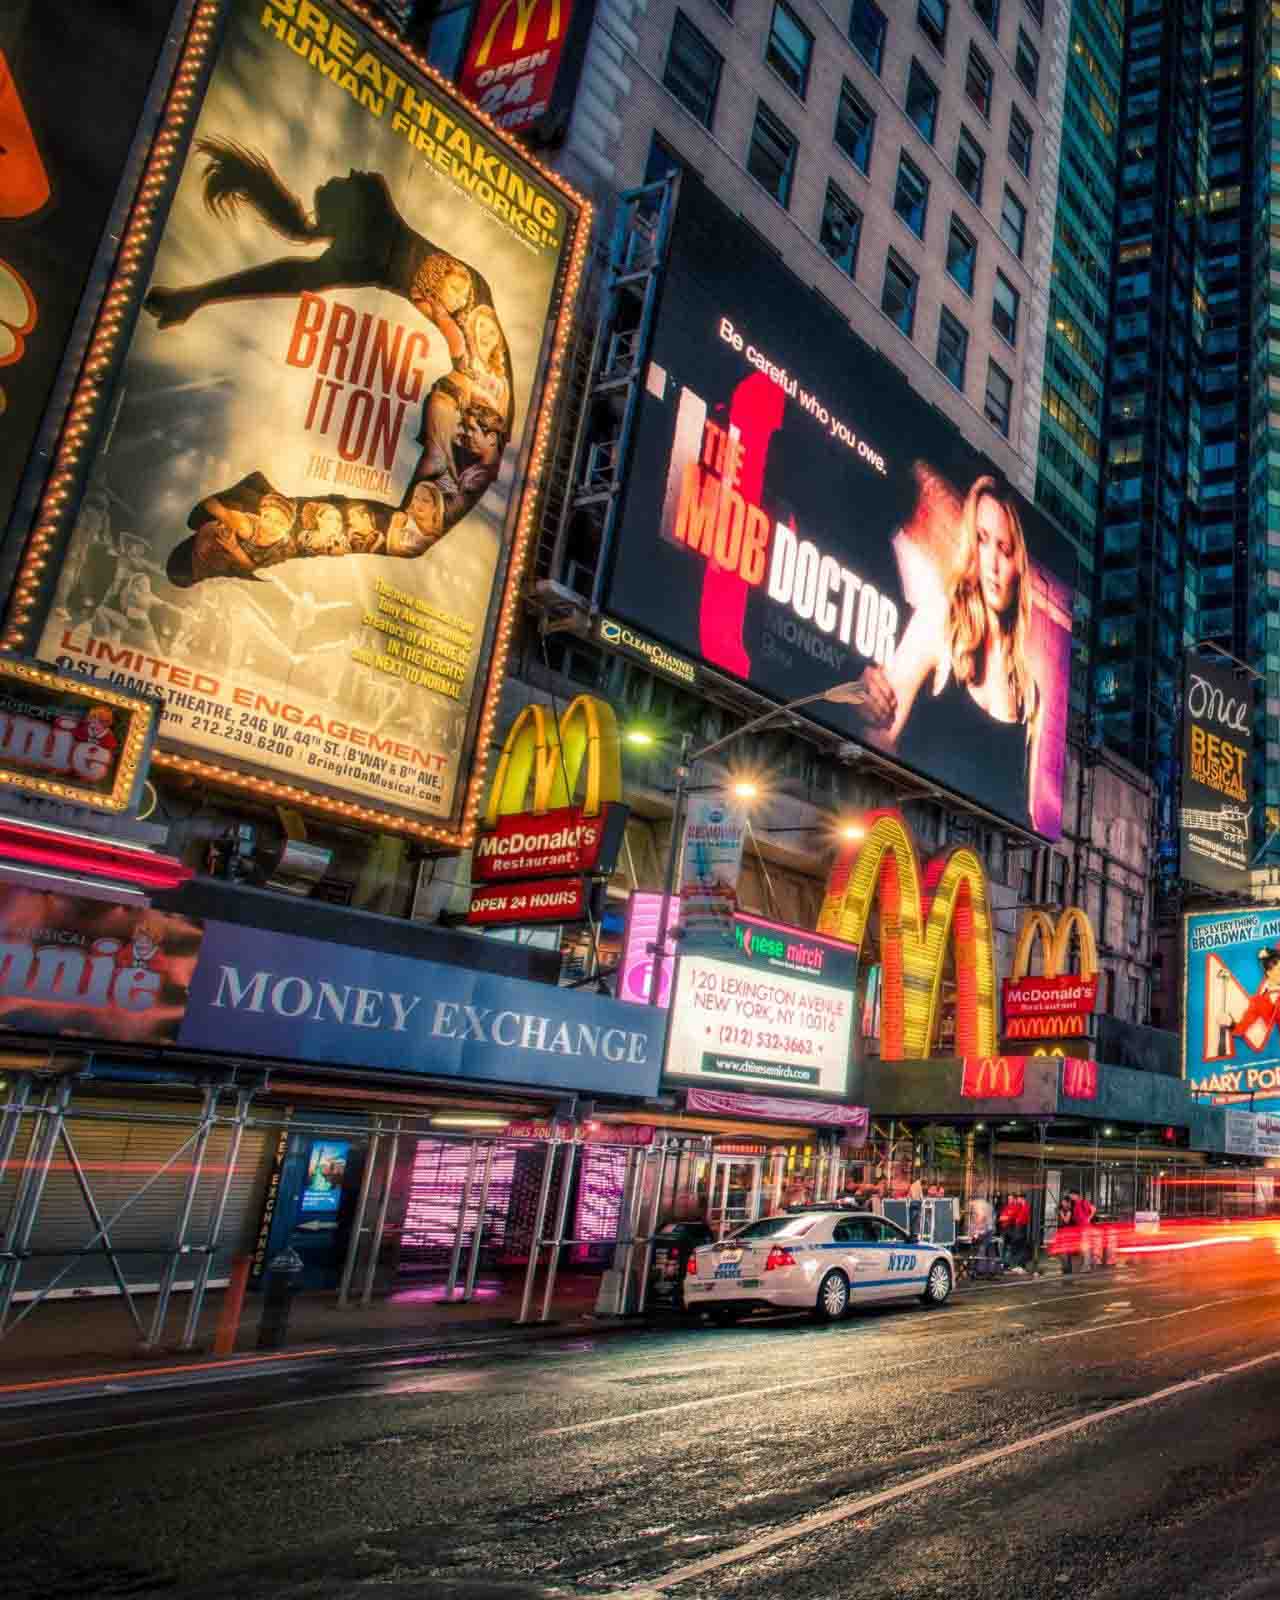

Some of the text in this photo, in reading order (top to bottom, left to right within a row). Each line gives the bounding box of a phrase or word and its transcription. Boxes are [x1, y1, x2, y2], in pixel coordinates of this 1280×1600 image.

[260, 6, 386, 118] HUMAN
[477, 49, 550, 87] OPEN
[286, 290, 430, 404] BRING
[719, 316, 887, 476] Be careful who you owe.
[304, 378, 406, 471] IT ON
[307, 455, 394, 492] THE MUSICAL
[703, 418, 745, 487] THE
[673, 463, 898, 665] MOB DOCTOR
[60, 630, 448, 772] LIMITED ENGAGEMENT
[104, 670, 166, 699] JAMES
[239, 711, 268, 734] 246
[191, 716, 441, 804] 212.239.6200 BringItOnMusical.com
[1191, 724, 1247, 771] BEST
[1191, 752, 1245, 792] MUSICAL
[478, 825, 598, 857] McDonald's
[471, 891, 577, 912] OPEN 24 HOURS
[210, 964, 648, 1064] MONEY EXCHANGE
[691, 968, 845, 1016] 120 LEXINGTON AVENUE
[694, 992, 730, 1012] NEW
[777, 1009, 794, 1025] NY
[800, 1012, 836, 1033] 10016
[1008, 986, 1094, 1003] McDonald's
[719, 1025, 753, 1048] (212)
[1190, 1071, 1243, 1092] MARY
[887, 1254, 918, 1272] NYPD
